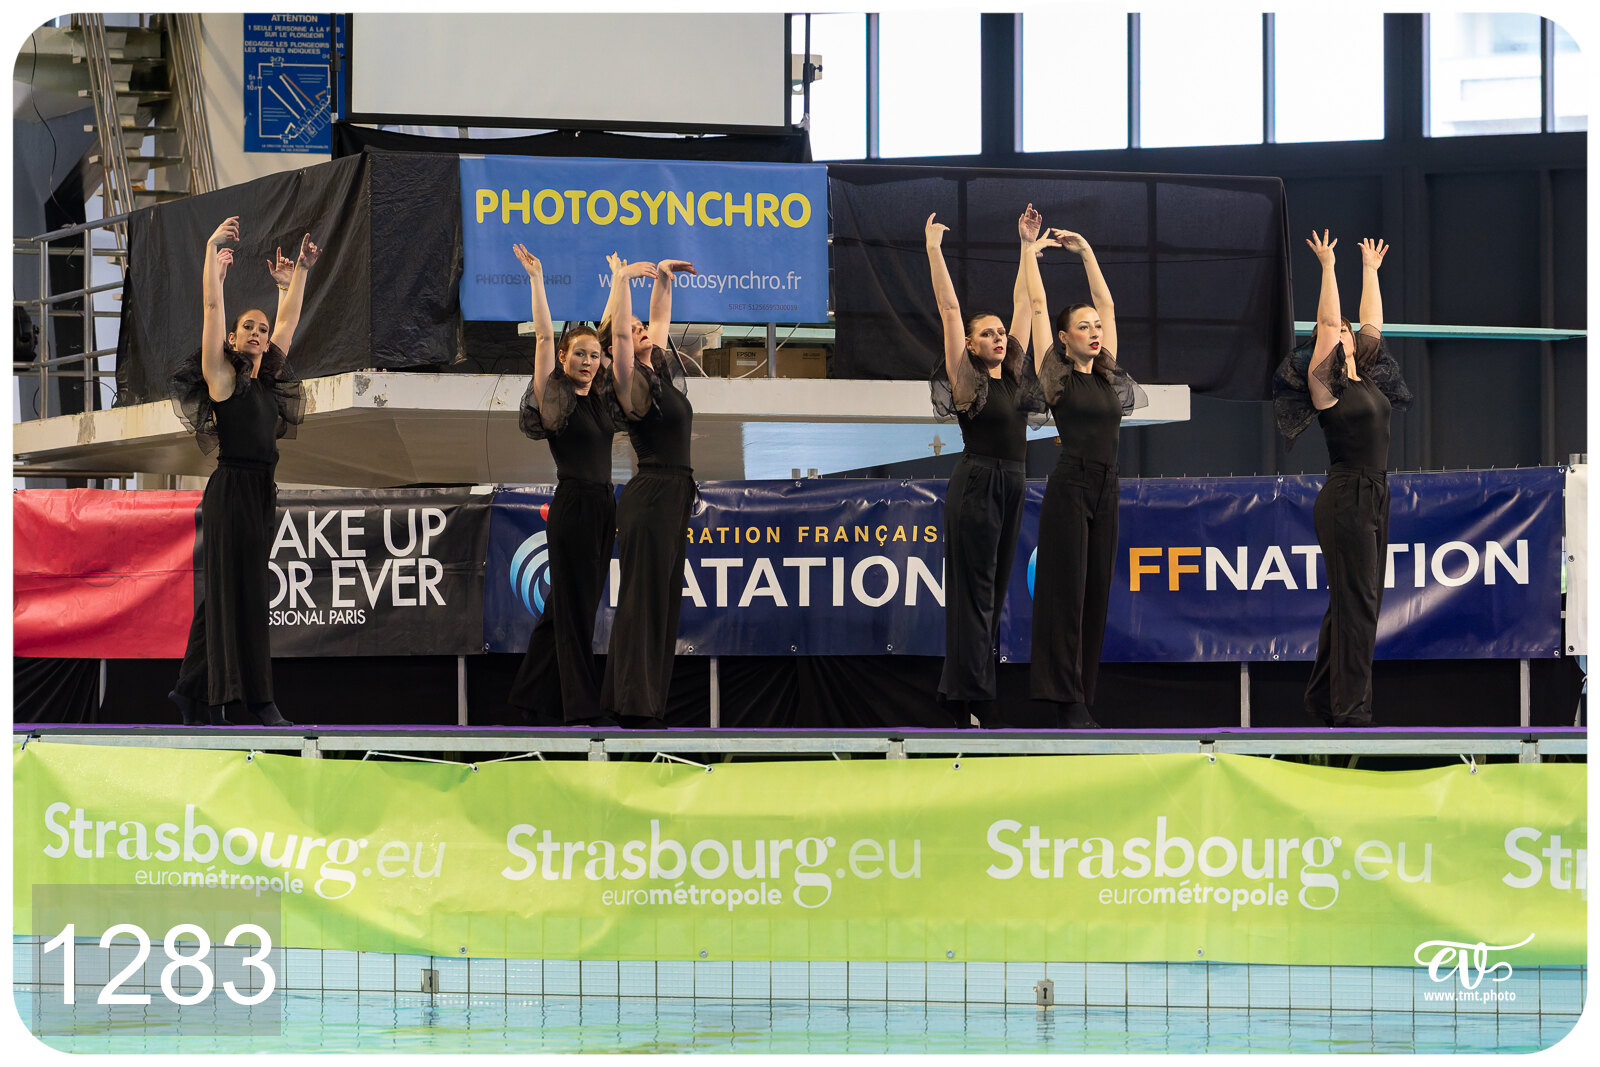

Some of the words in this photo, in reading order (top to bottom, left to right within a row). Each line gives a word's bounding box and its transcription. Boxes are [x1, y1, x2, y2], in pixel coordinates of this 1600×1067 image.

[271, 14, 318, 23] ATTENTION
[290, 41, 330, 49] PLONGEOIRS
[475, 188, 812, 228] PHOTOSYNCHRO
[728, 303, 746, 311] SIRET
[270, 508, 366, 559] AKE
[382, 507, 447, 558] UP
[798, 524, 945, 546] FRANÇAIS
[1129, 539, 1530, 592] FFNATTION
[331, 557, 447, 610] EVER
[328, 608, 366, 625] PARIS
[43, 801, 446, 900] Strasbourg.eu
[501, 818, 922, 909] Strasbourg.eu
[985, 815, 1433, 910] Strasbourg.eu
[135, 865, 304, 897] eurométropole
[601, 881, 782, 912] eurométropole
[1098, 880, 1289, 912] eurométropole
